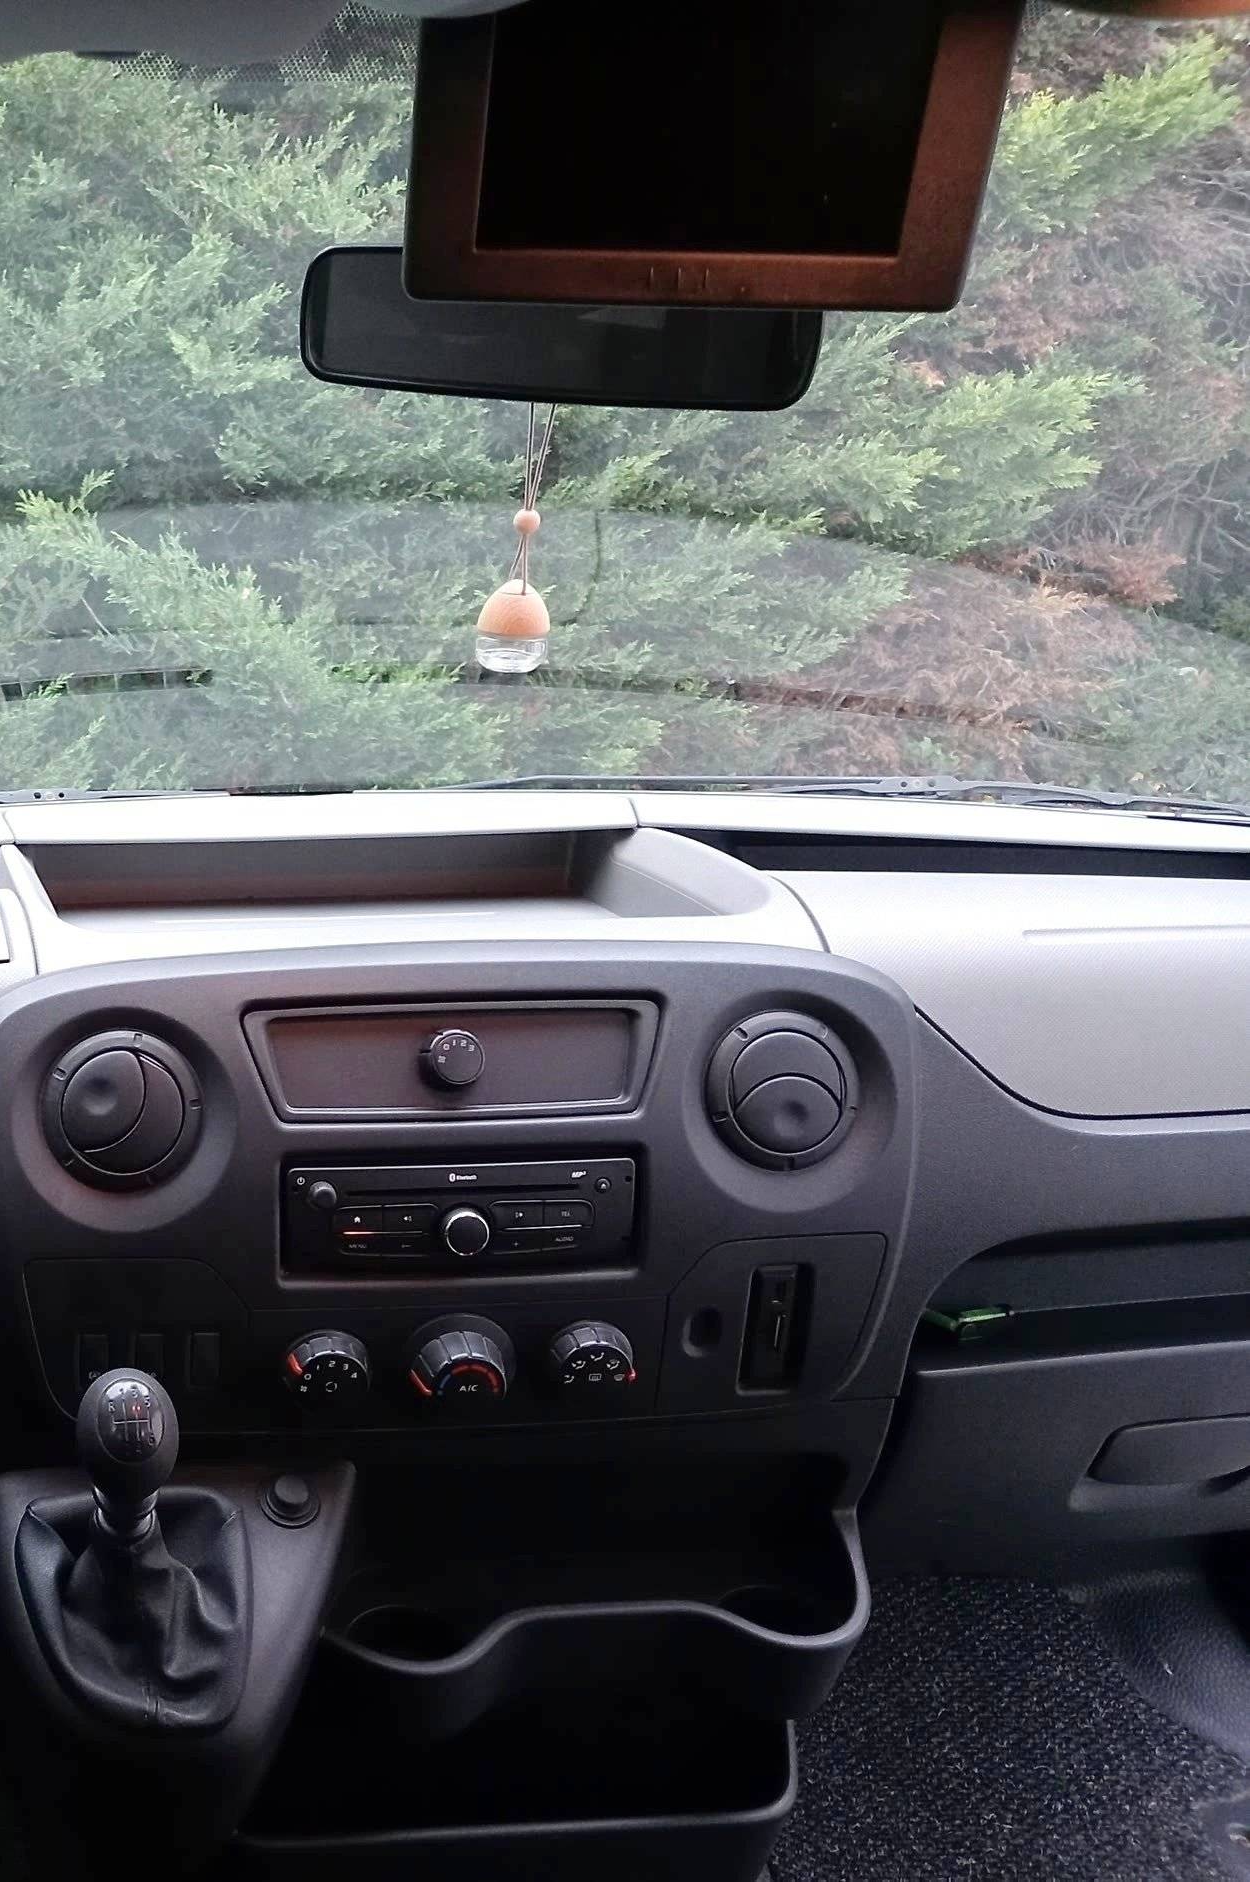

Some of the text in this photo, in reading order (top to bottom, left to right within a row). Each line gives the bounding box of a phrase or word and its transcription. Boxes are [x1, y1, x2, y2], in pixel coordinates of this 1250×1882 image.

[329, 1360, 336, 1368] 2
[342, 1363, 349, 1371] 3
[460, 1384, 478, 1392] A/C
